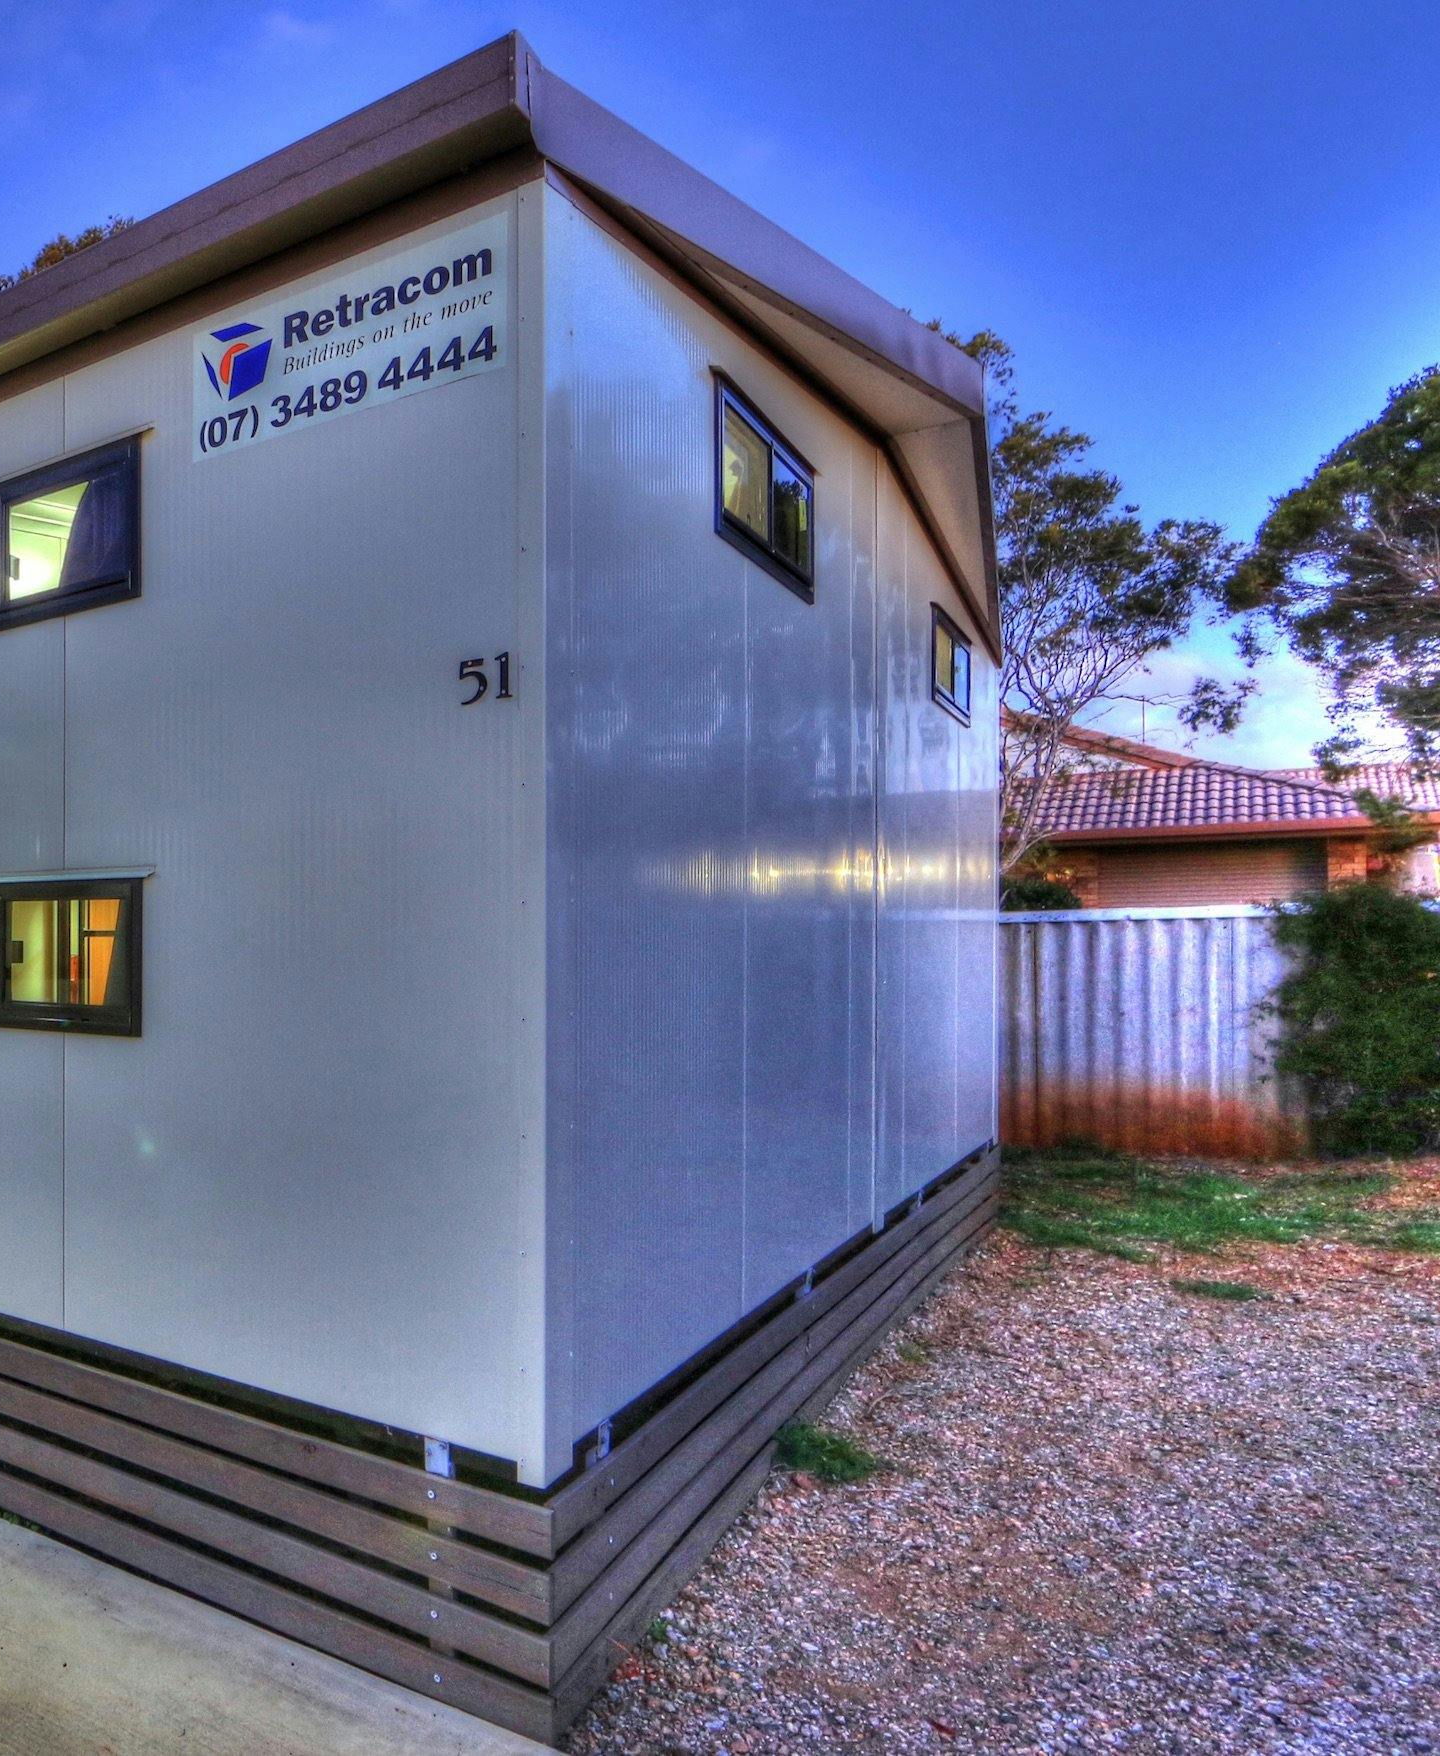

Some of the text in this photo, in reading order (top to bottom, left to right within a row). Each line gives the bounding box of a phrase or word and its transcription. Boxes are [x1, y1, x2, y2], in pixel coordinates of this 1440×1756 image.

[283, 248, 492, 348] Retracom
[283, 288, 492, 375] Buildings on the move
[199, 325, 497, 453] (07) 3489 4444
[459, 651, 513, 706] 51
